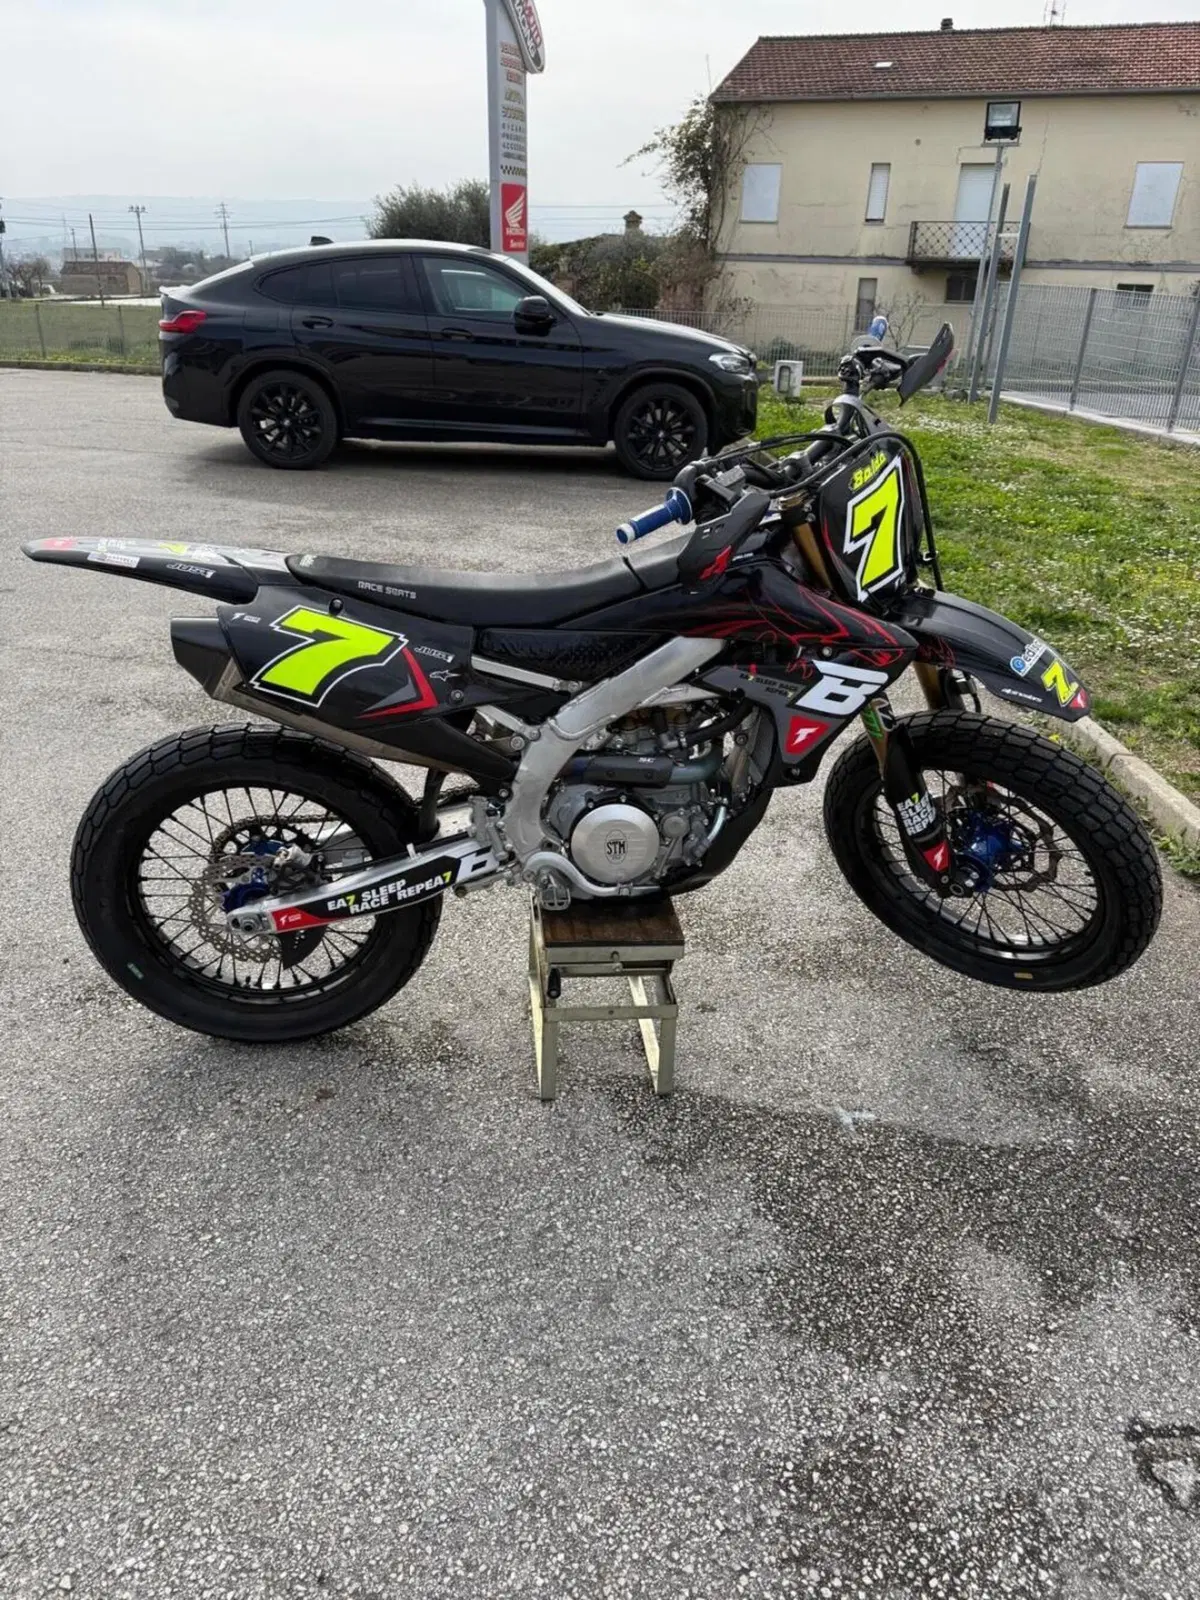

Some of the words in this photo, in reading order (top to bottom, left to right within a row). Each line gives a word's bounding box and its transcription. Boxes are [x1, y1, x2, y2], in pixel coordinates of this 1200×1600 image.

[848, 462, 902, 595] 7
[358, 581, 383, 593] RACE
[256, 607, 401, 701] 7
[606, 840, 627, 855] STM
[326, 894, 356, 911] EA7
[361, 879, 406, 902] SLEEP
[349, 894, 390, 914] RACE
[396, 870, 452, 900] REPEA7
